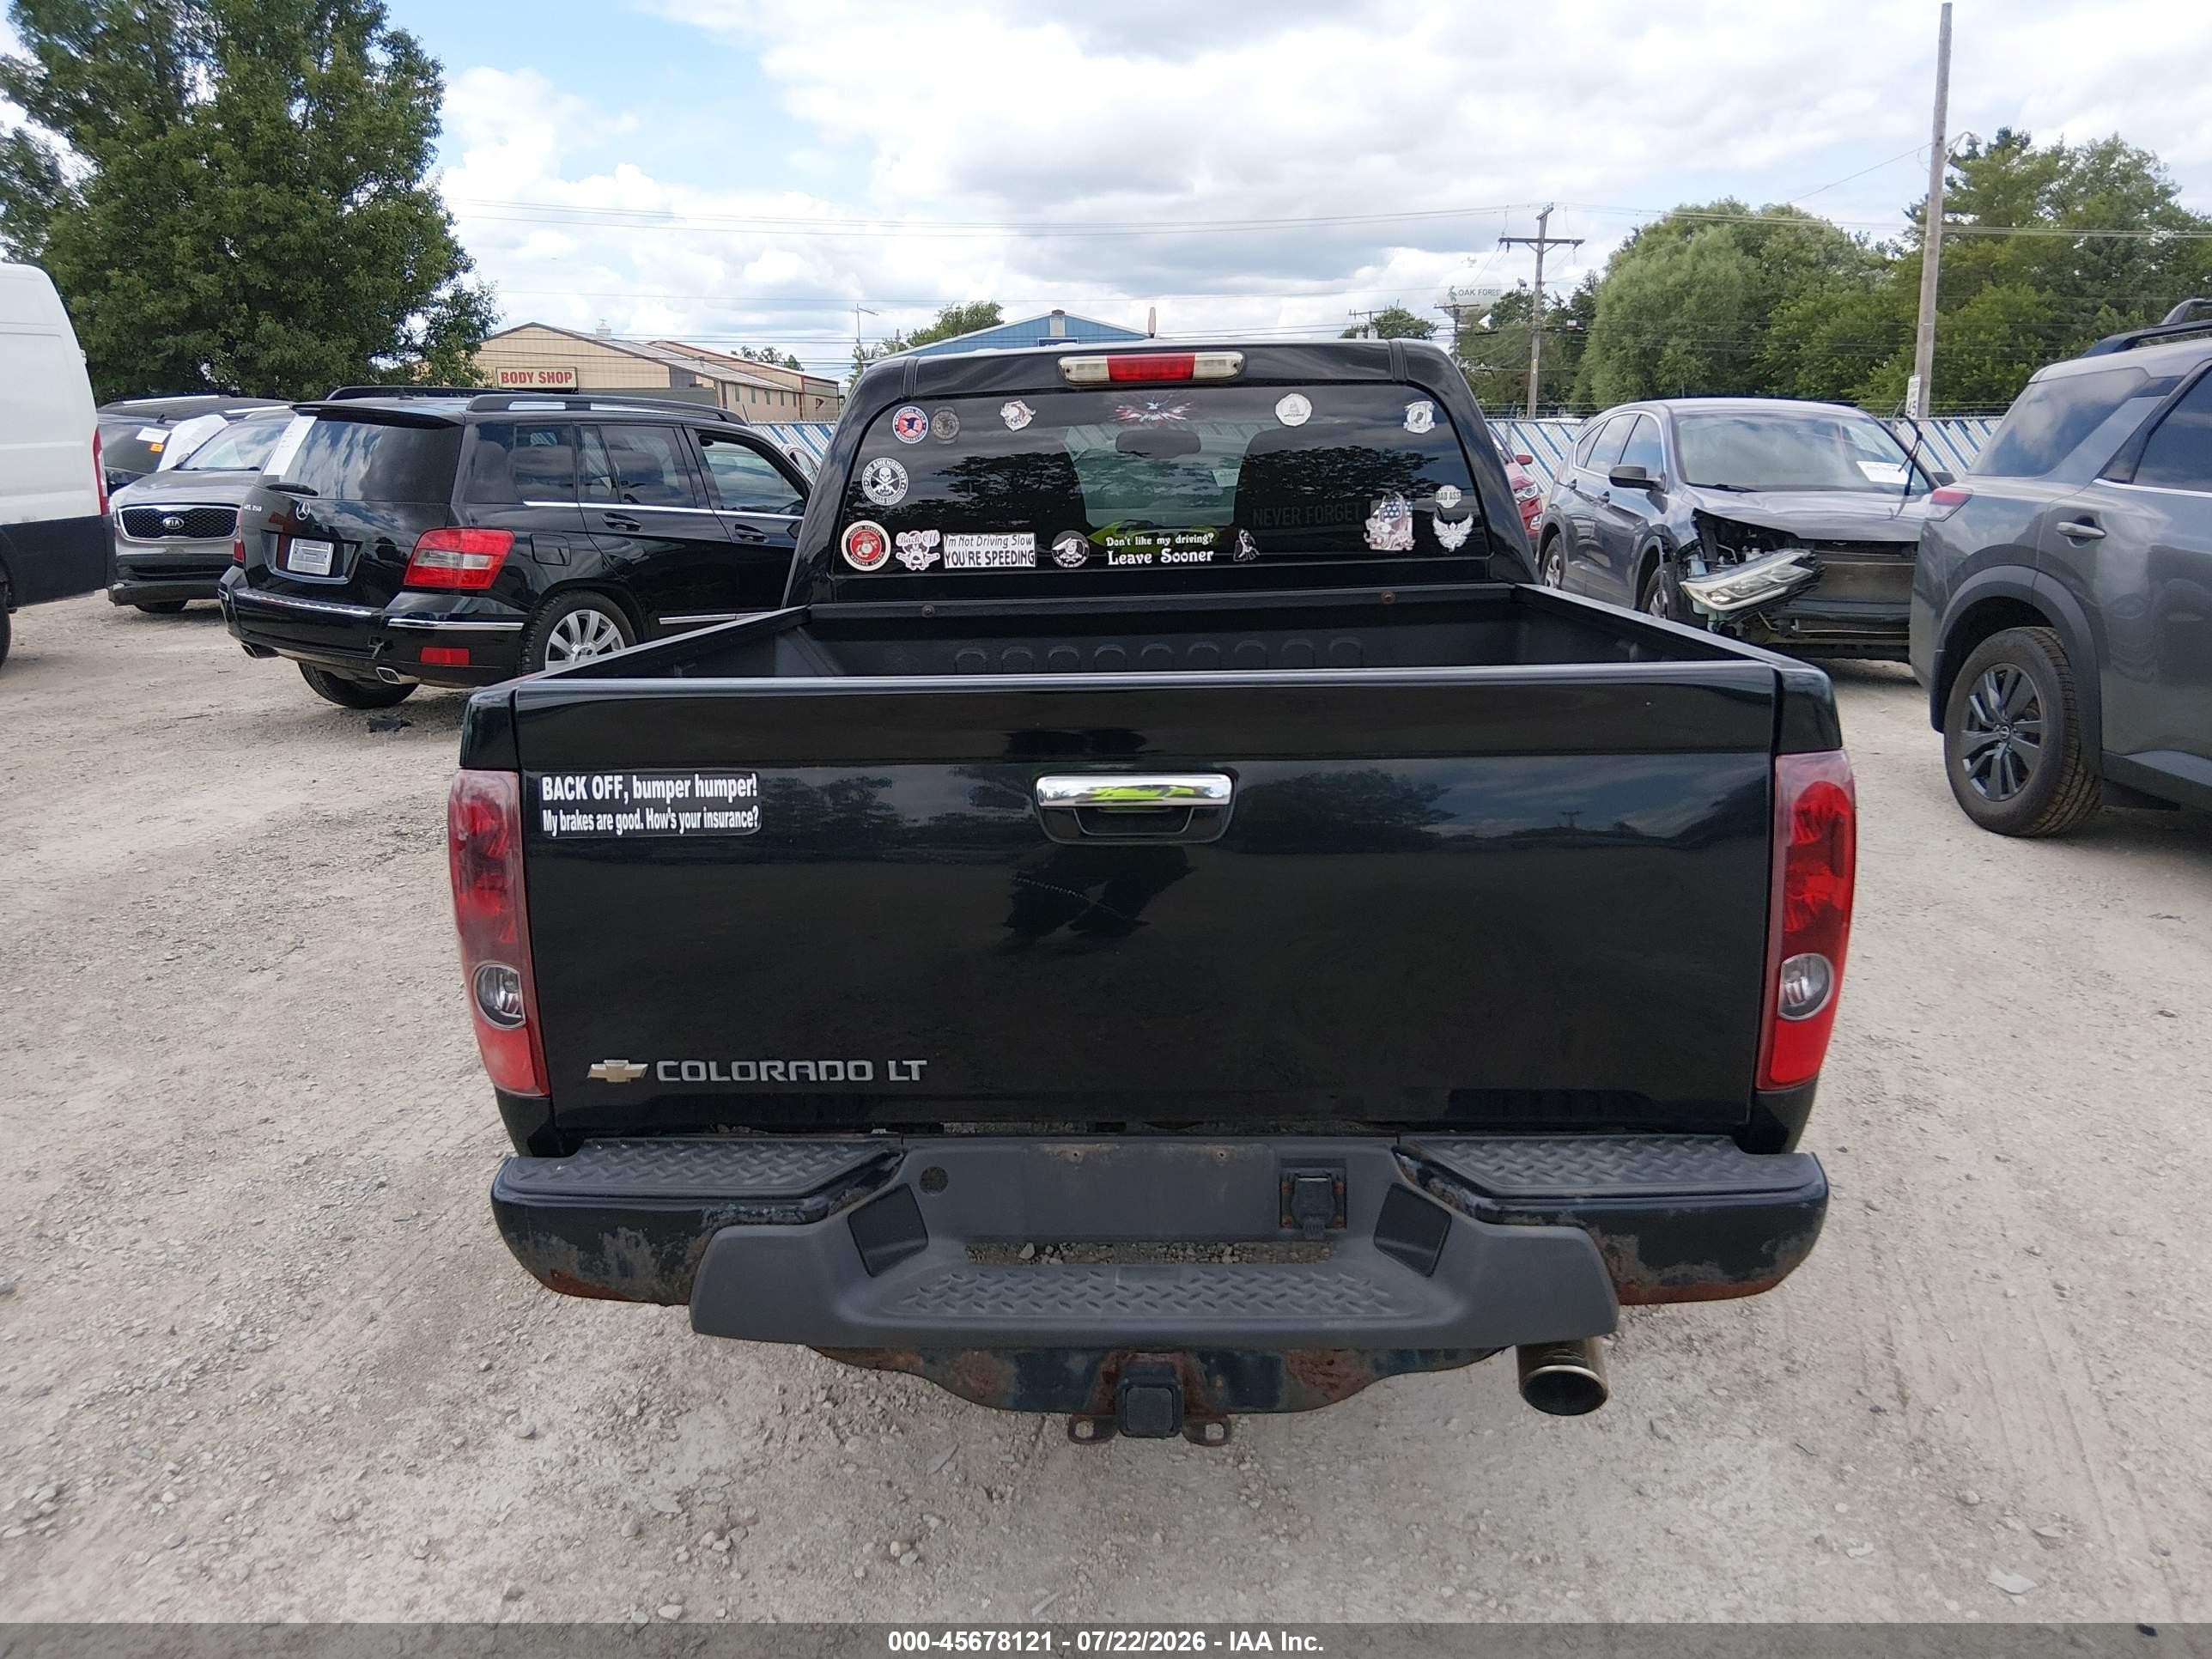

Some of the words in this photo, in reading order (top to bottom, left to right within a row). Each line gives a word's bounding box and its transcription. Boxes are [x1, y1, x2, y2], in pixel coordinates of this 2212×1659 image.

[501, 371, 534, 384] BODY
[538, 371, 573, 385] SHOP
[1907, 400, 1917, 416] 45
[864, 467, 873, 482] 2ND
[873, 459, 907, 483] AMENDMENT
[1436, 492, 1447, 501] BAD
[1451, 491, 1462, 500] ASS
[1253, 506, 1302, 527] NEVER
[1306, 502, 1361, 524] FORGET
[958, 535, 974, 547] Not
[976, 535, 1008, 549] Driving
[1011, 534, 1033, 546] Slow
[1106, 536, 1131, 547] Don't
[1135, 536, 1152, 545] like
[1157, 537, 1171, 546] my
[1175, 532, 1214, 546] driving?
[945, 550, 982, 566] YOU'RE
[985, 550, 1035, 566] SPEEDING
[1107, 550, 1152, 566] Leave
[1160, 548, 1214, 563] Sooner
[541, 775, 588, 801] BACK
[592, 775, 629, 805] OFF,
[632, 775, 690, 804] bumper
[695, 773, 757, 804] humper!
[543, 809, 557, 836] My
[560, 807, 594, 831] brakes
[596, 814, 613, 830] are
[615, 807, 644, 836] good.
[646, 807, 677, 830] How's
[678, 812, 702, 834] your
[703, 805, 758, 830] insurance?
[656, 1060, 874, 1081] COLORADO
[888, 1060, 928, 1081] LT
